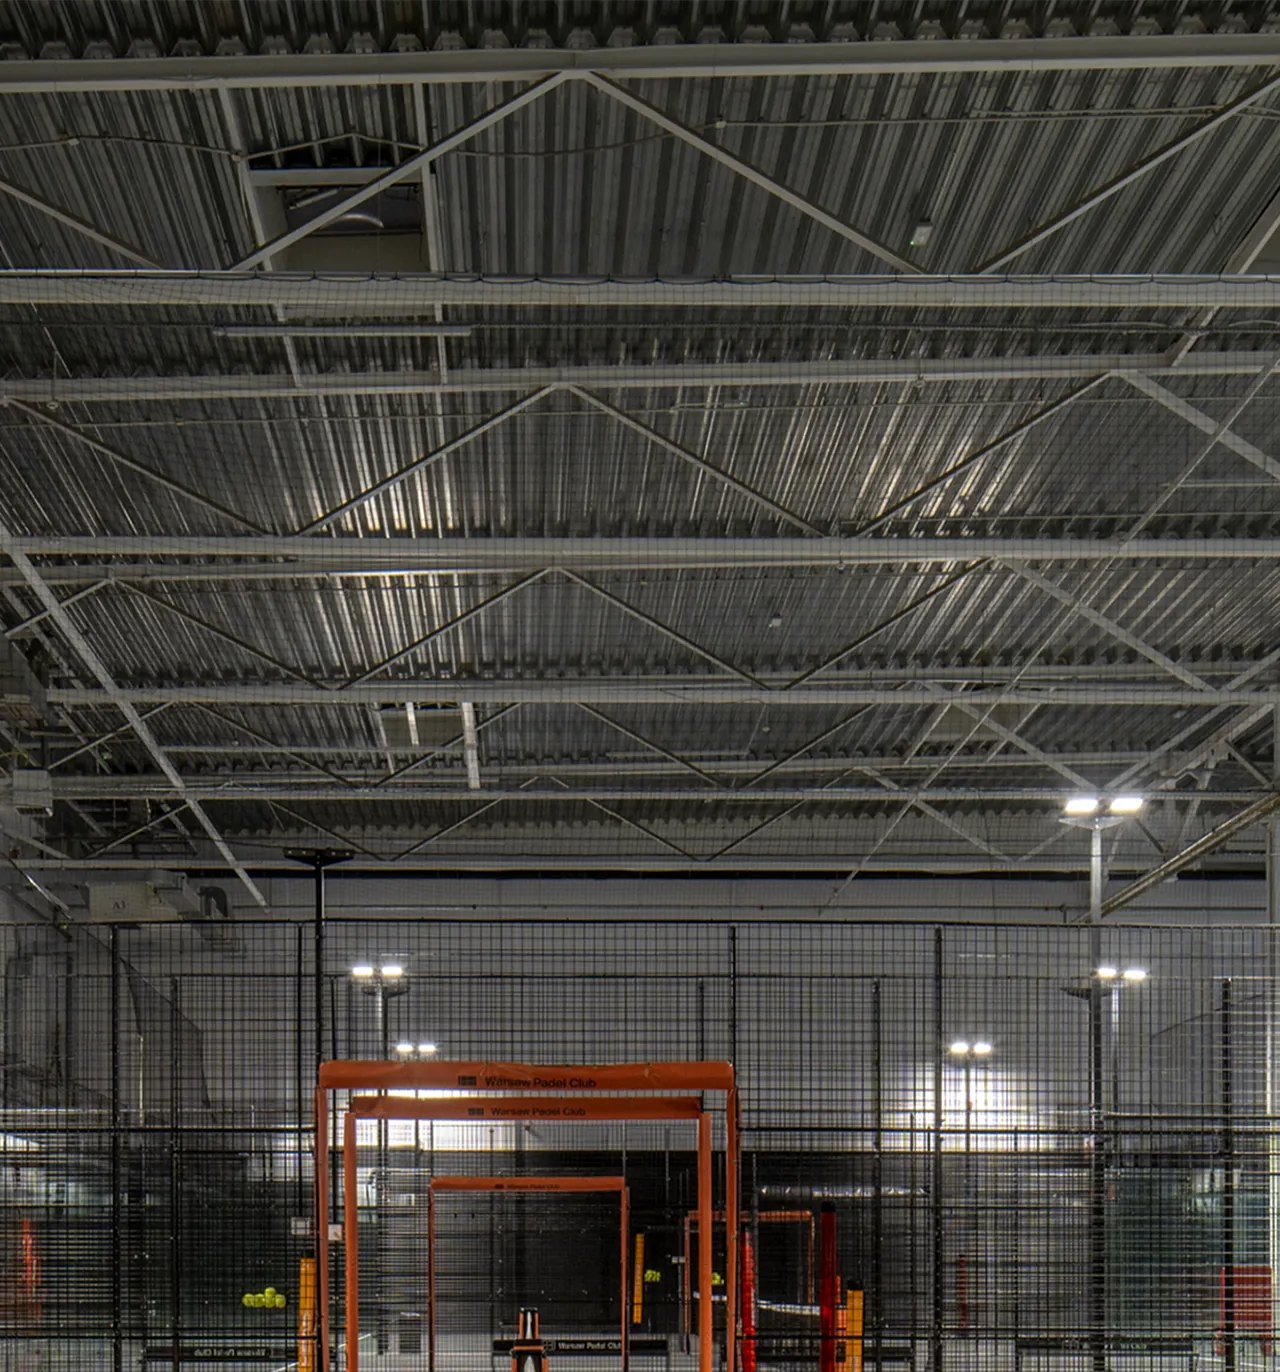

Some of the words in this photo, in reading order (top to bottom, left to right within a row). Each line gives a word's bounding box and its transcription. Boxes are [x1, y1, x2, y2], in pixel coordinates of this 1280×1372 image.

[485, 1077, 530, 1087] Warsaw
[533, 1078, 566, 1088] Padel
[569, 1078, 596, 1088] Club
[491, 1107, 529, 1116] Warsaw
[532, 1107, 560, 1116] Padel
[563, 1107, 586, 1116] Club
